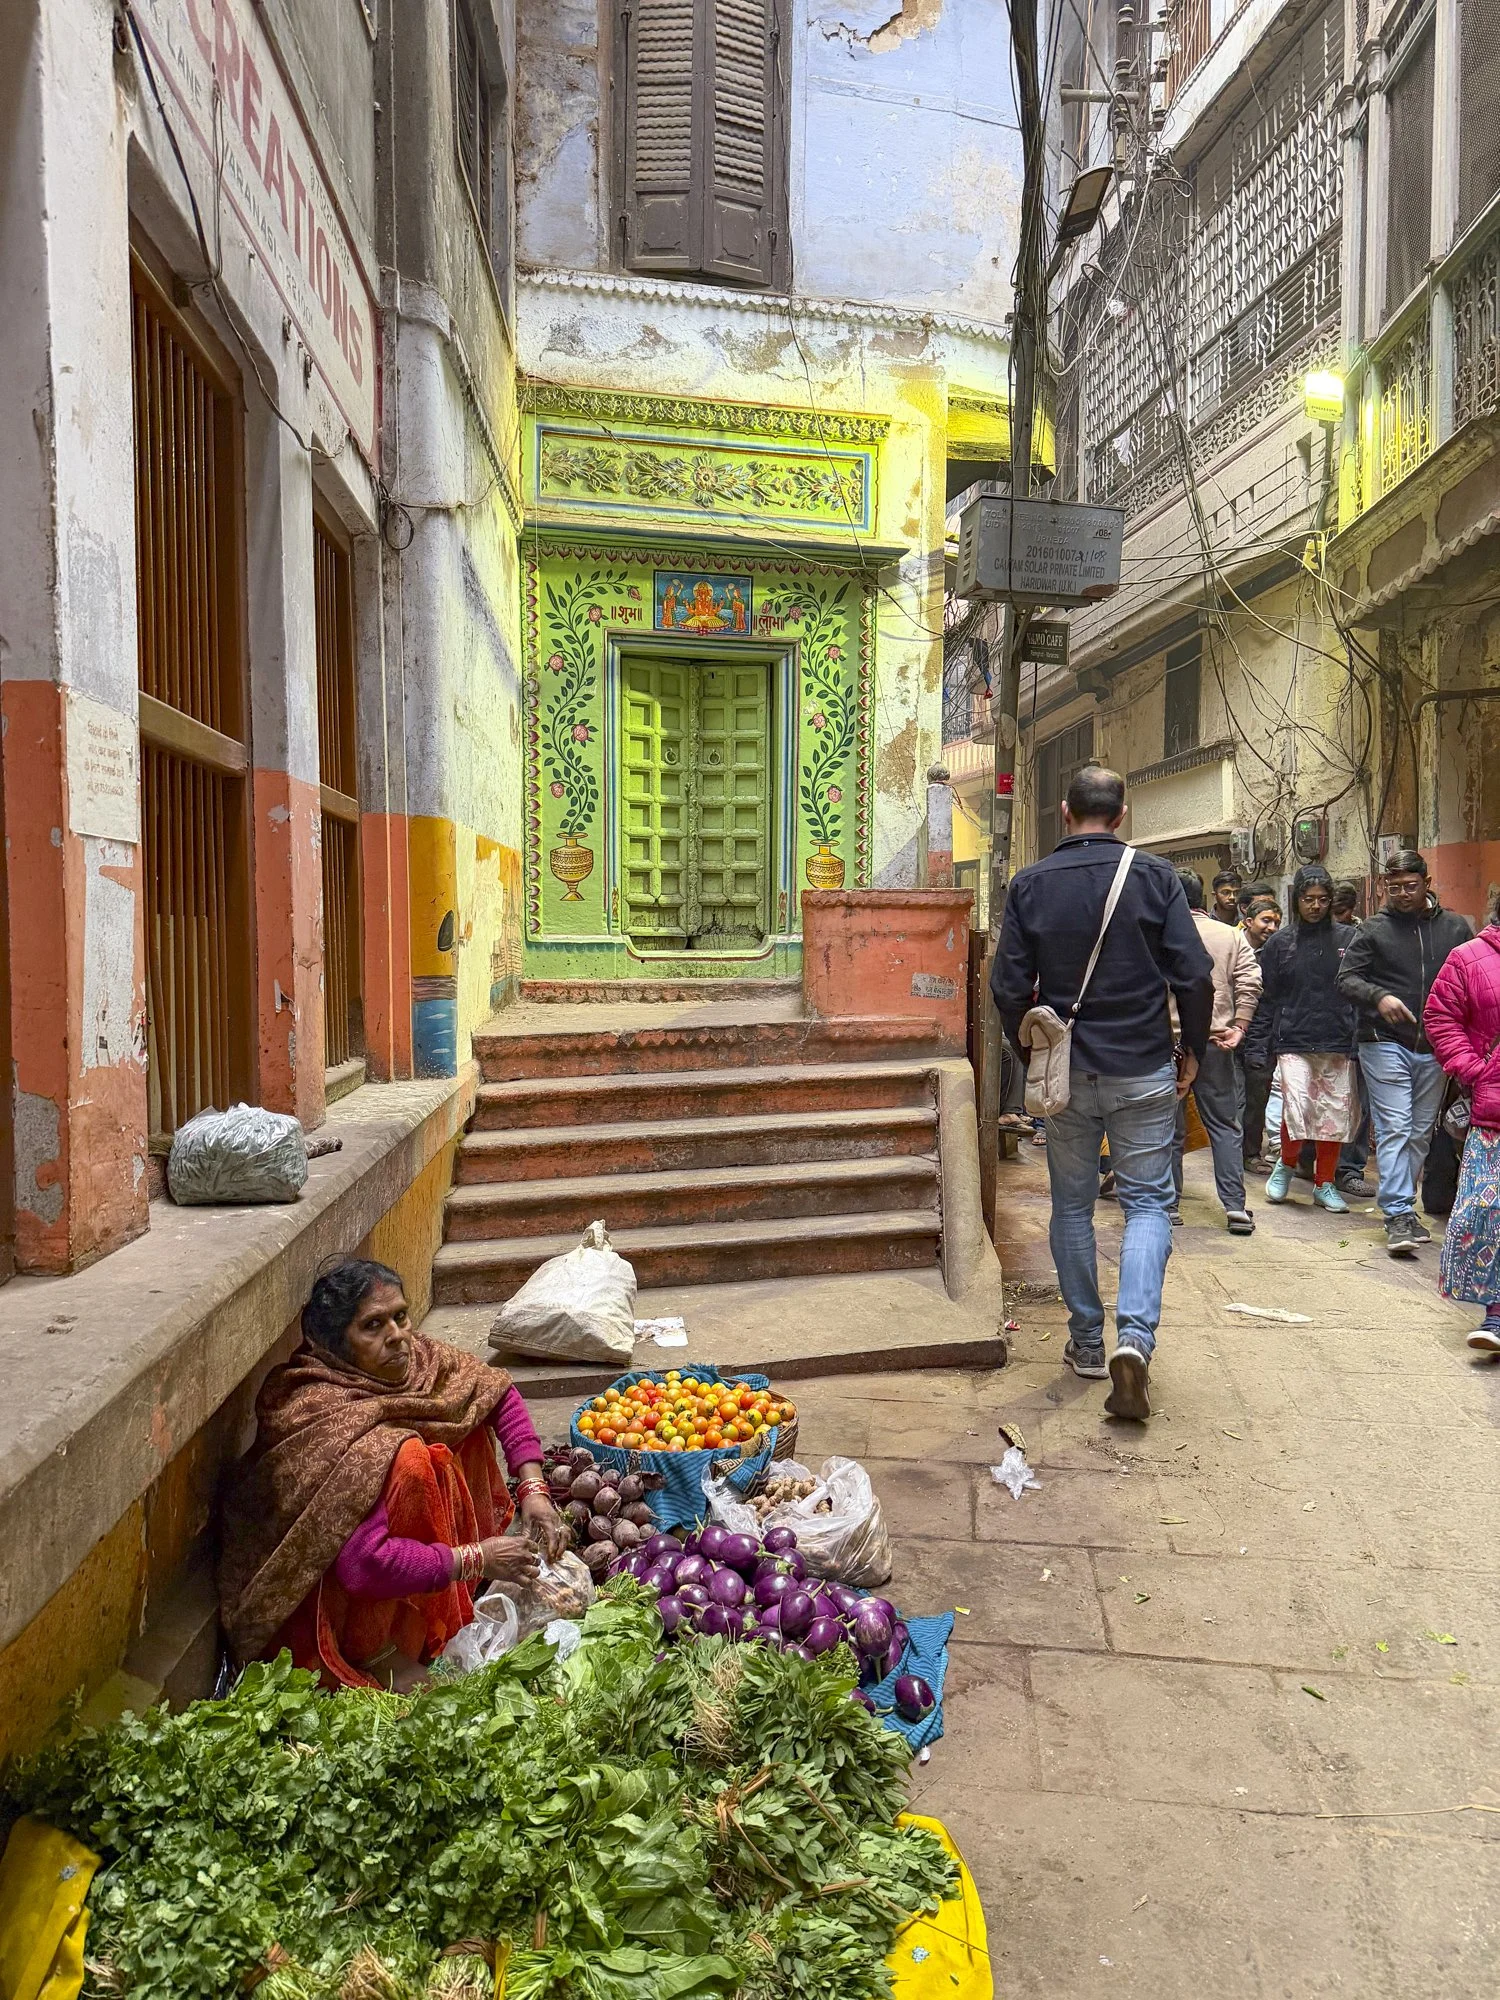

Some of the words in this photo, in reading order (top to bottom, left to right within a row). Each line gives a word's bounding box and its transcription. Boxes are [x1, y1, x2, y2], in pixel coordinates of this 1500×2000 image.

[1024, 559, 1049, 575] SOLAR
[1049, 562, 1078, 577] PRIVATE
[1078, 565, 1105, 579] LIMITED
[1046, 634, 1064, 647] CAFE
